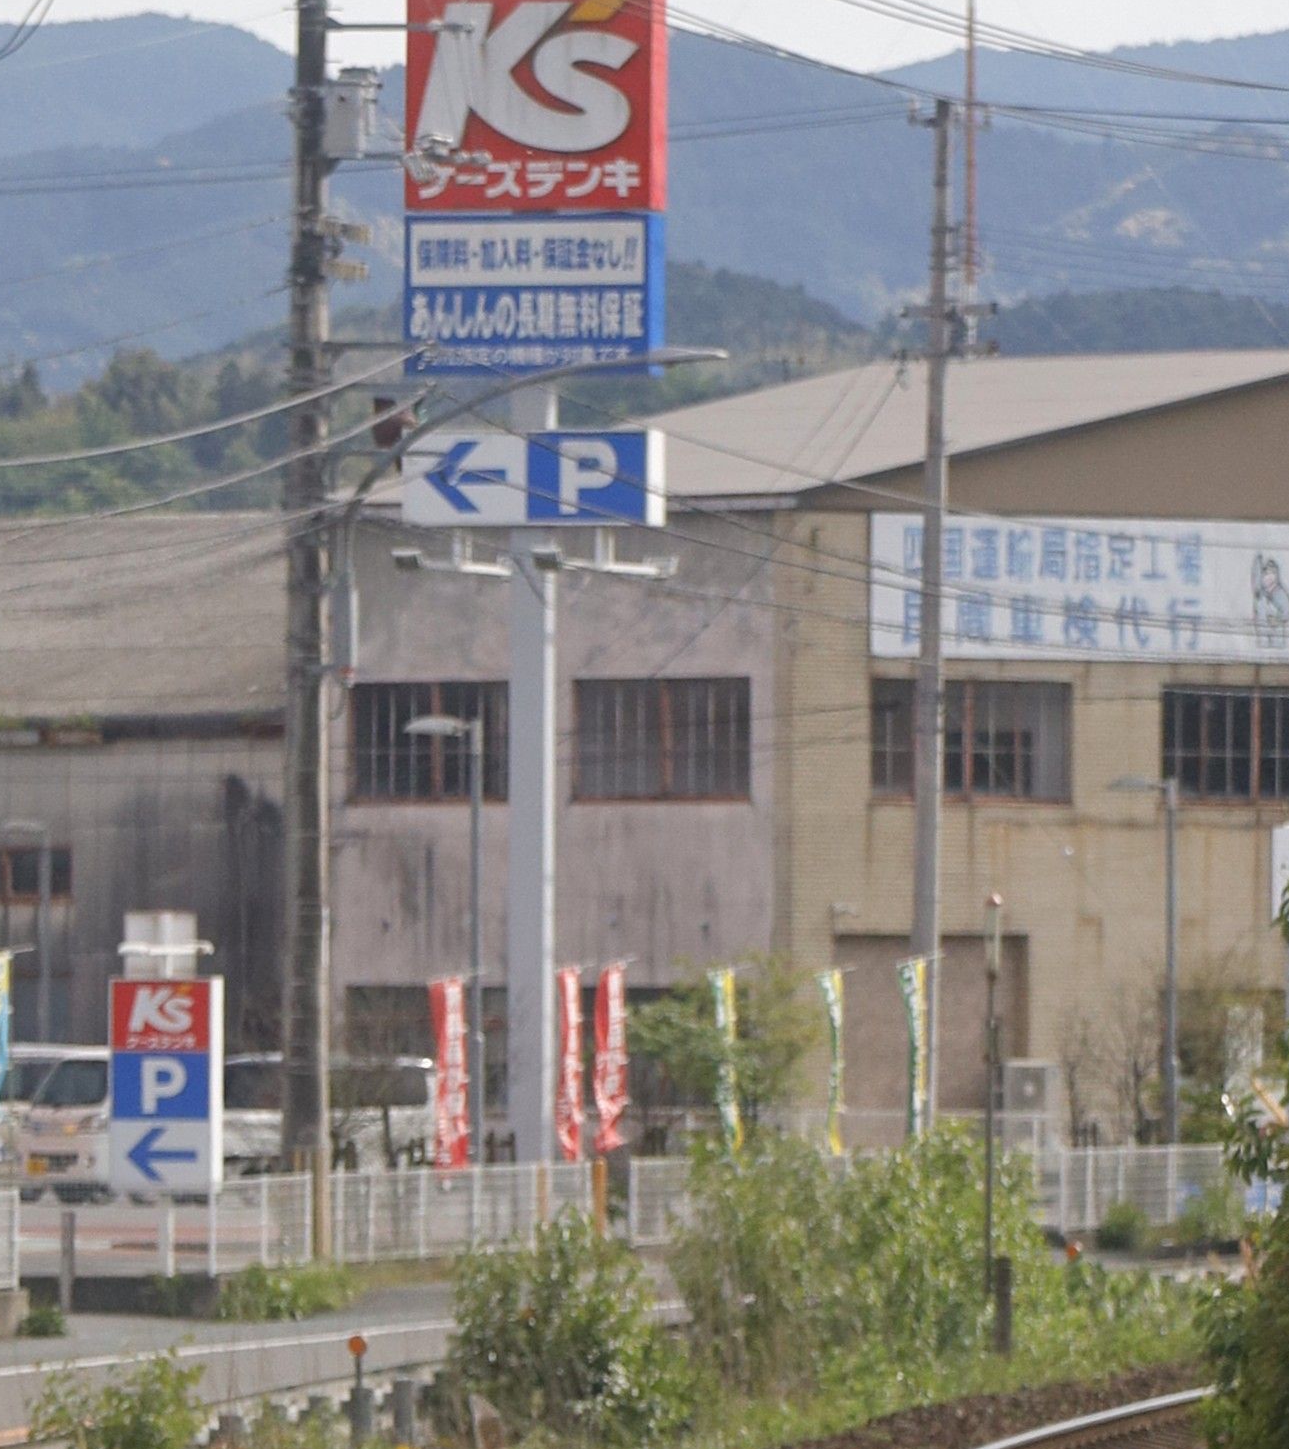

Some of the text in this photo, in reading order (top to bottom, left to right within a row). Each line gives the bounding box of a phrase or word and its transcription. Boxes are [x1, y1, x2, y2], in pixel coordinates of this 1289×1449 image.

[410, 290, 645, 340] あんしんの長期無料保証
[558, 440, 618, 516] P
[140, 1056, 188, 1115] P
